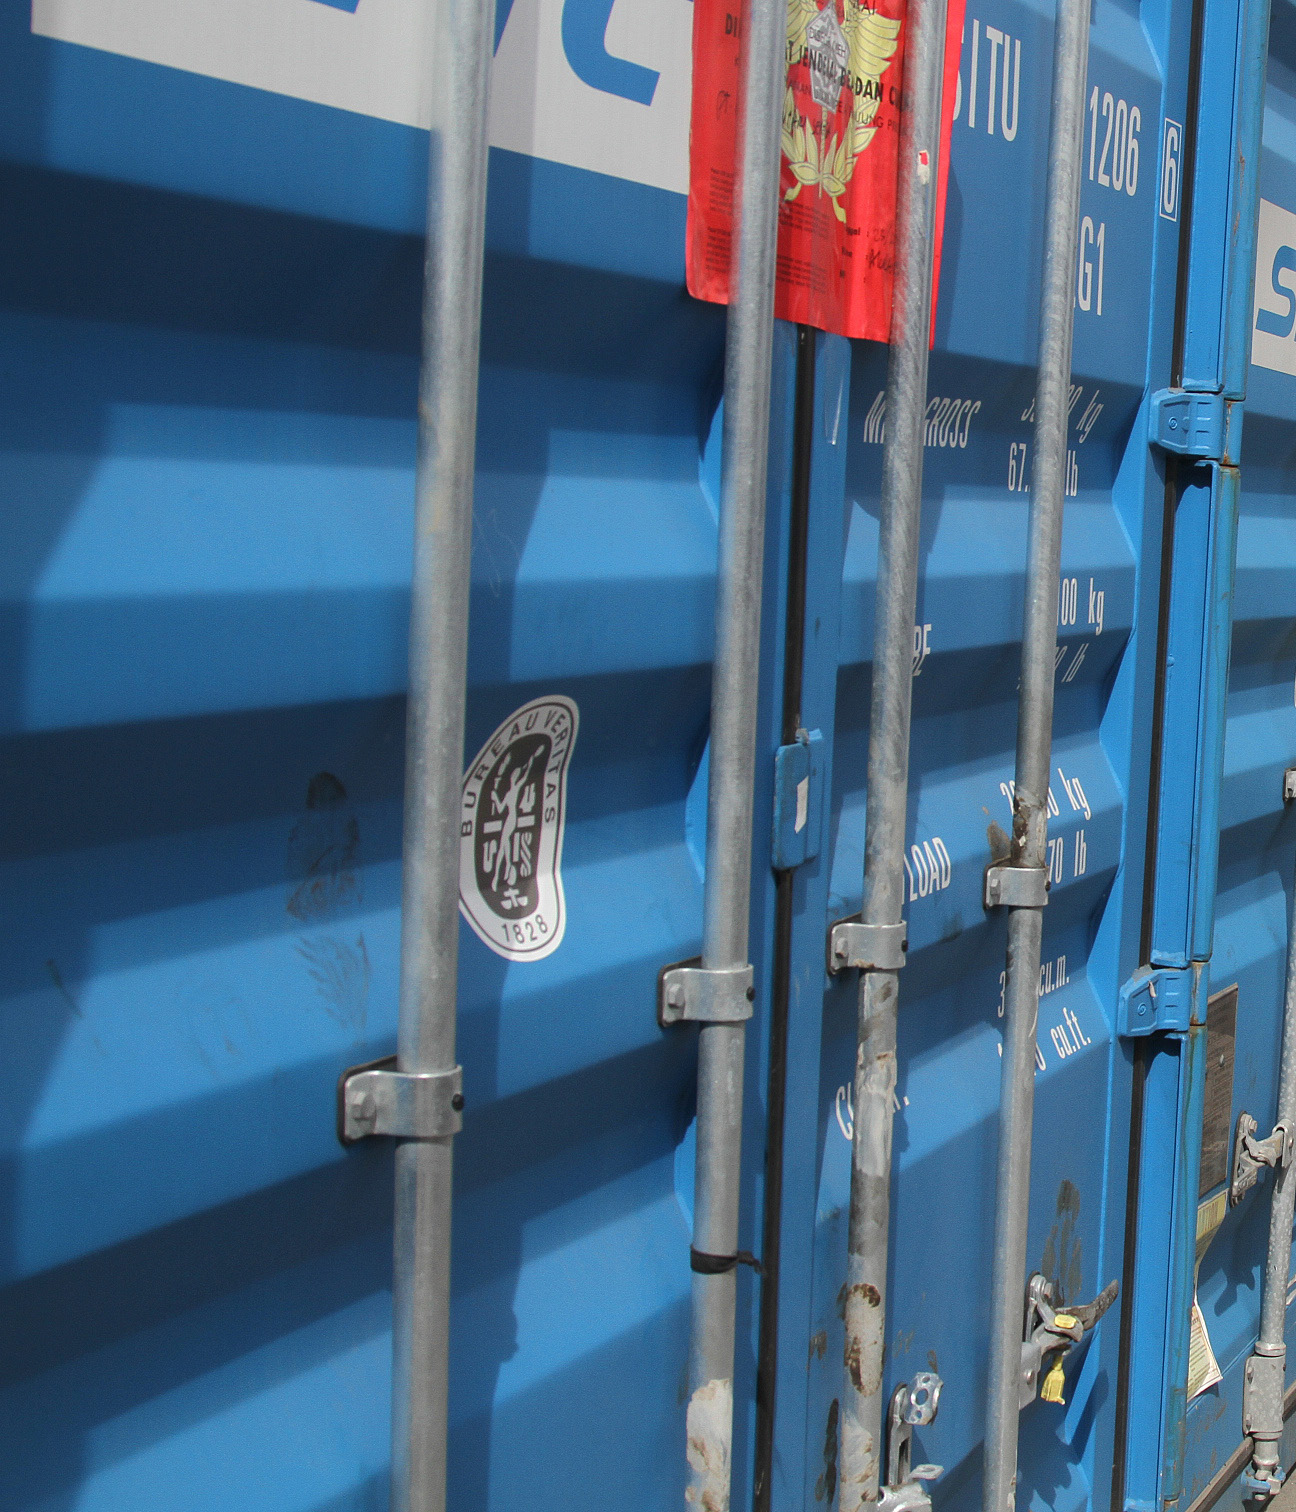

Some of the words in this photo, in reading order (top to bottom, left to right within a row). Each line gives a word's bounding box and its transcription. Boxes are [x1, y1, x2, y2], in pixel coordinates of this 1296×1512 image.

[856, 76, 884, 103] DAN
[1089, 85, 1142, 197] 1206
[1162, 124, 1179, 215] 6
[1074, 216, 1106, 316] G1
[923, 396, 982, 449] GROSS
[1075, 389, 1104, 444] kg
[1065, 449, 1079, 497] lb
[1056, 578, 1078, 626] 00
[1087, 577, 1105, 636] kg
[1061, 643, 1090, 683] lb
[461, 711, 539, 838] BUREAU
[543, 708, 569, 824] VERITAS
[1057, 767, 1092, 821] kg
[902, 836, 951, 905] LOAD
[1073, 829, 1087, 877] lb
[502, 912, 549, 944] 1828
[1050, 1006, 1092, 1059] cu.ft.
